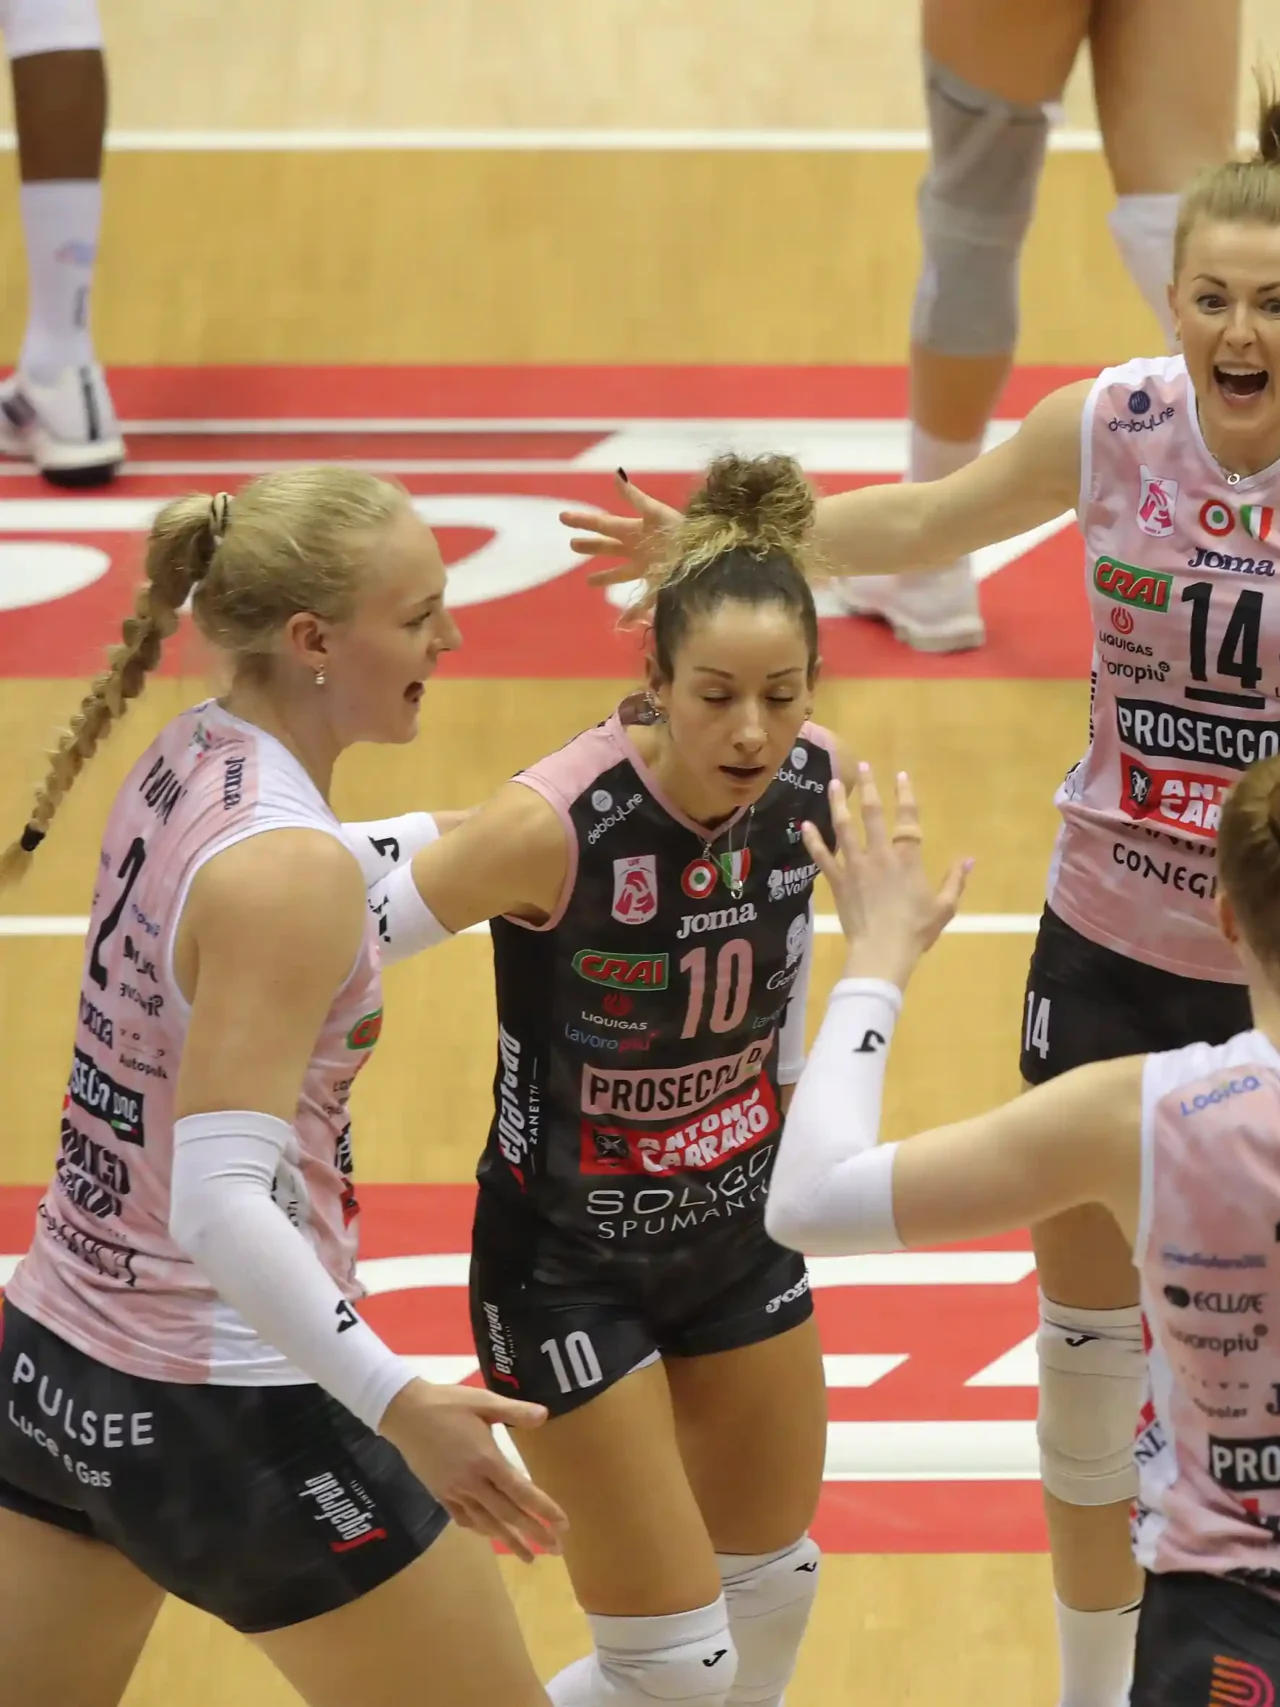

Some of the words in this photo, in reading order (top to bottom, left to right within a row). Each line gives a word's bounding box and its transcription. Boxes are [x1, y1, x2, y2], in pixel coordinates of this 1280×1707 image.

[1096, 557, 1168, 607] CRAI
[1187, 546, 1276, 577] Joma
[1098, 630, 1154, 657] LIQUIGAS
[1181, 581, 1265, 690] 14
[1117, 705, 1279, 762] PROSECCO
[676, 902, 758, 940] Joma
[581, 955, 664, 986] CRAI
[679, 938, 754, 1040] 10
[581, 1009, 649, 1031] LIQUIGAS
[1024, 989, 1052, 1060] 14
[641, 1104, 770, 1173] CARRARO
[539, 1330, 604, 1394] 10
[11, 1352, 156, 1448] PULSEE
[8, 1399, 61, 1458] Luce
[75, 1459, 113, 1489] Gas
